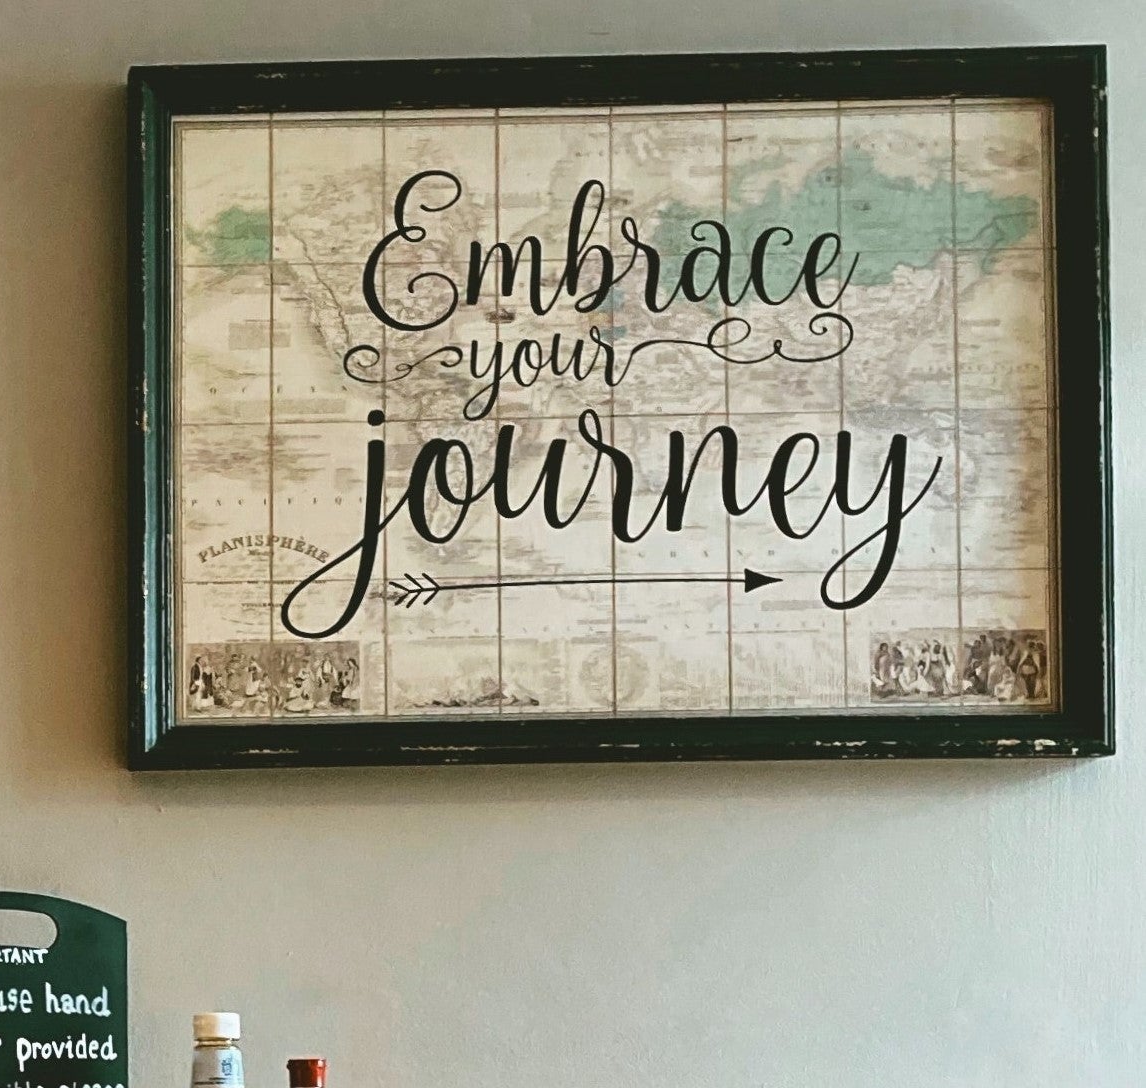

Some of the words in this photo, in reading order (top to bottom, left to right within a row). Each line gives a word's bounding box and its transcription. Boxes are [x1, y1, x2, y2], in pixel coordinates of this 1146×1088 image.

[363, 170, 860, 332] Embrace
[461, 325, 635, 421] your
[281, 409, 944, 639] journey
[44, 981, 112, 1018] hand
[16, 1032, 118, 1073] provided
